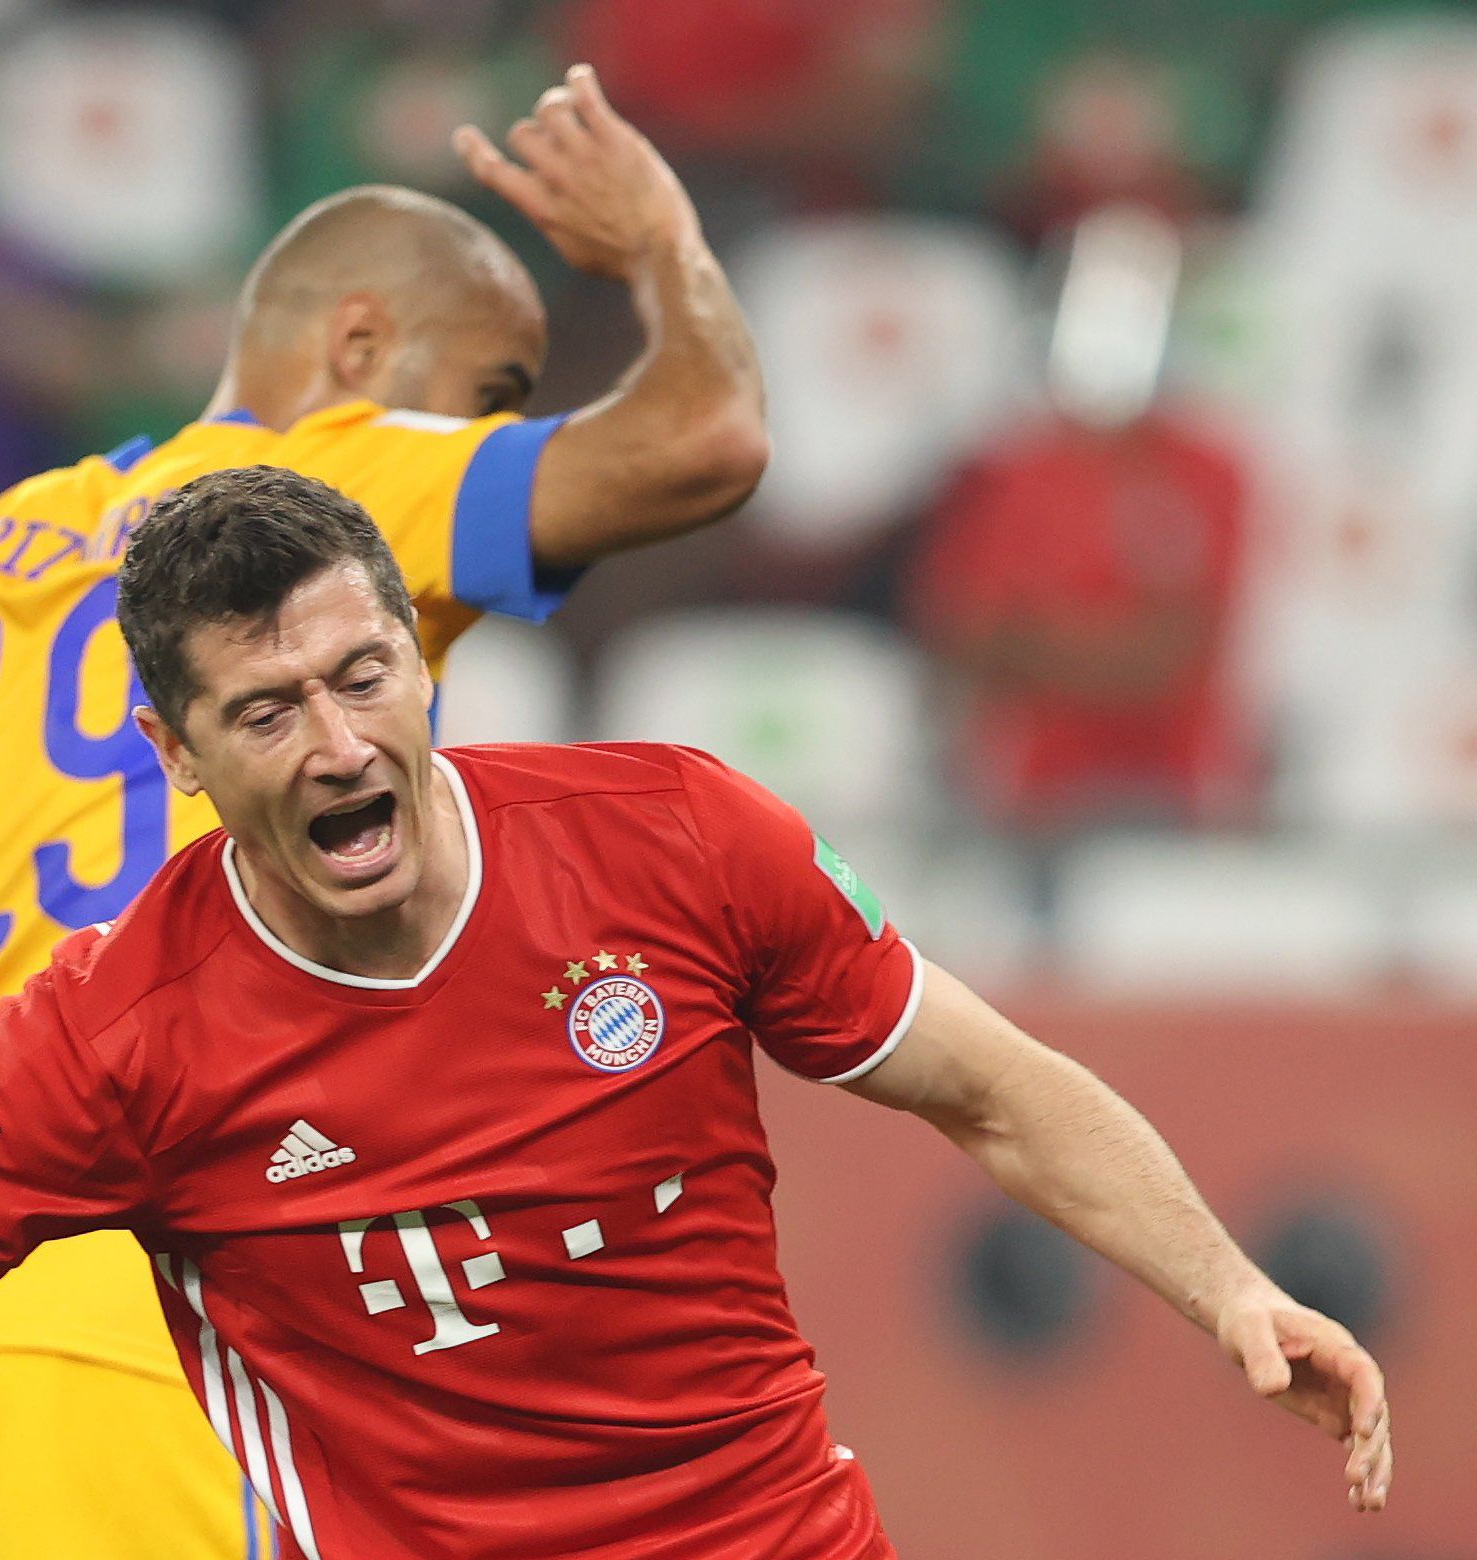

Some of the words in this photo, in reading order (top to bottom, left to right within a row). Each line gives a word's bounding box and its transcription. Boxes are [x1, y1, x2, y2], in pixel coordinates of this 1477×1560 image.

[574, 1009, 591, 1032] FC
[583, 982, 650, 1008] BAYERN
[265, 1146, 357, 1184] adidas
[337, 1198, 506, 1356] T
